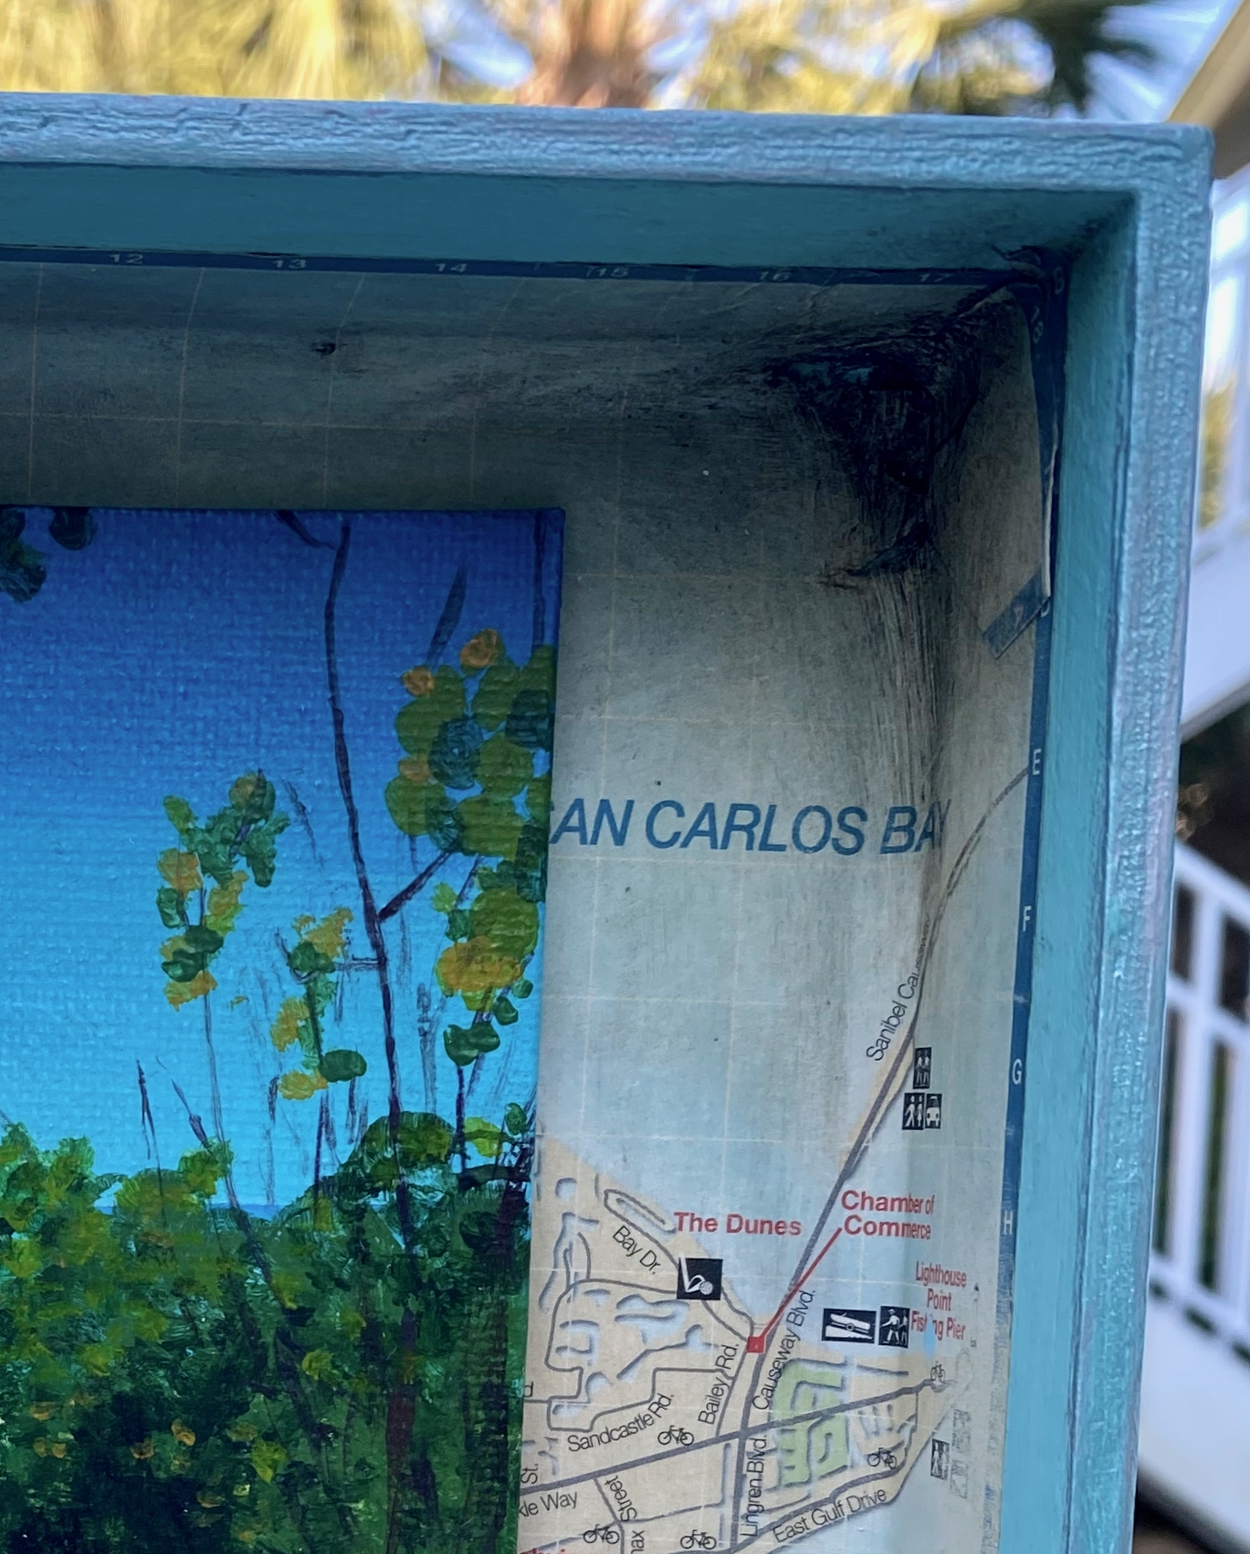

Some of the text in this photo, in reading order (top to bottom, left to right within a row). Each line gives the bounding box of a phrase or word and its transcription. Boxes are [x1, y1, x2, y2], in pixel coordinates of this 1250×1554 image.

[109, 253, 144, 265] 12
[272, 258, 307, 270] 13
[434, 262, 469, 274] 14
[1031, 748, 1042, 776] E
[549, 797, 635, 847] AN
[645, 800, 869, 856] CARLOS
[1022, 906, 1032, 931] F
[866, 1000, 908, 1061] Sanibel
[1011, 1059, 1023, 1084] G
[842, 1189, 935, 1215] Chamber of
[674, 1211, 802, 1236] The Dunes
[844, 1214, 931, 1240] Commerce
[1002, 1210, 1014, 1236] H
[613, 1225, 662, 1275] Bay Dr.
[915, 1260, 967, 1288] Lighthouse
[927, 1288, 952, 1311] Point
[911, 1310, 966, 1341] Fisng Pier
[752, 1289, 816, 1410] Causeway Blvd.
[697, 1343, 740, 1425] Bailey Rd.
[567, 1393, 675, 1452] Sandcastle Rd.
[746, 1434, 768, 1474] Blvd.
[520, 1463, 539, 1485] St.
[540, 1491, 578, 1512] Way
[604, 1475, 638, 1523] Street
[772, 1488, 887, 1543] East Gulf Drive
